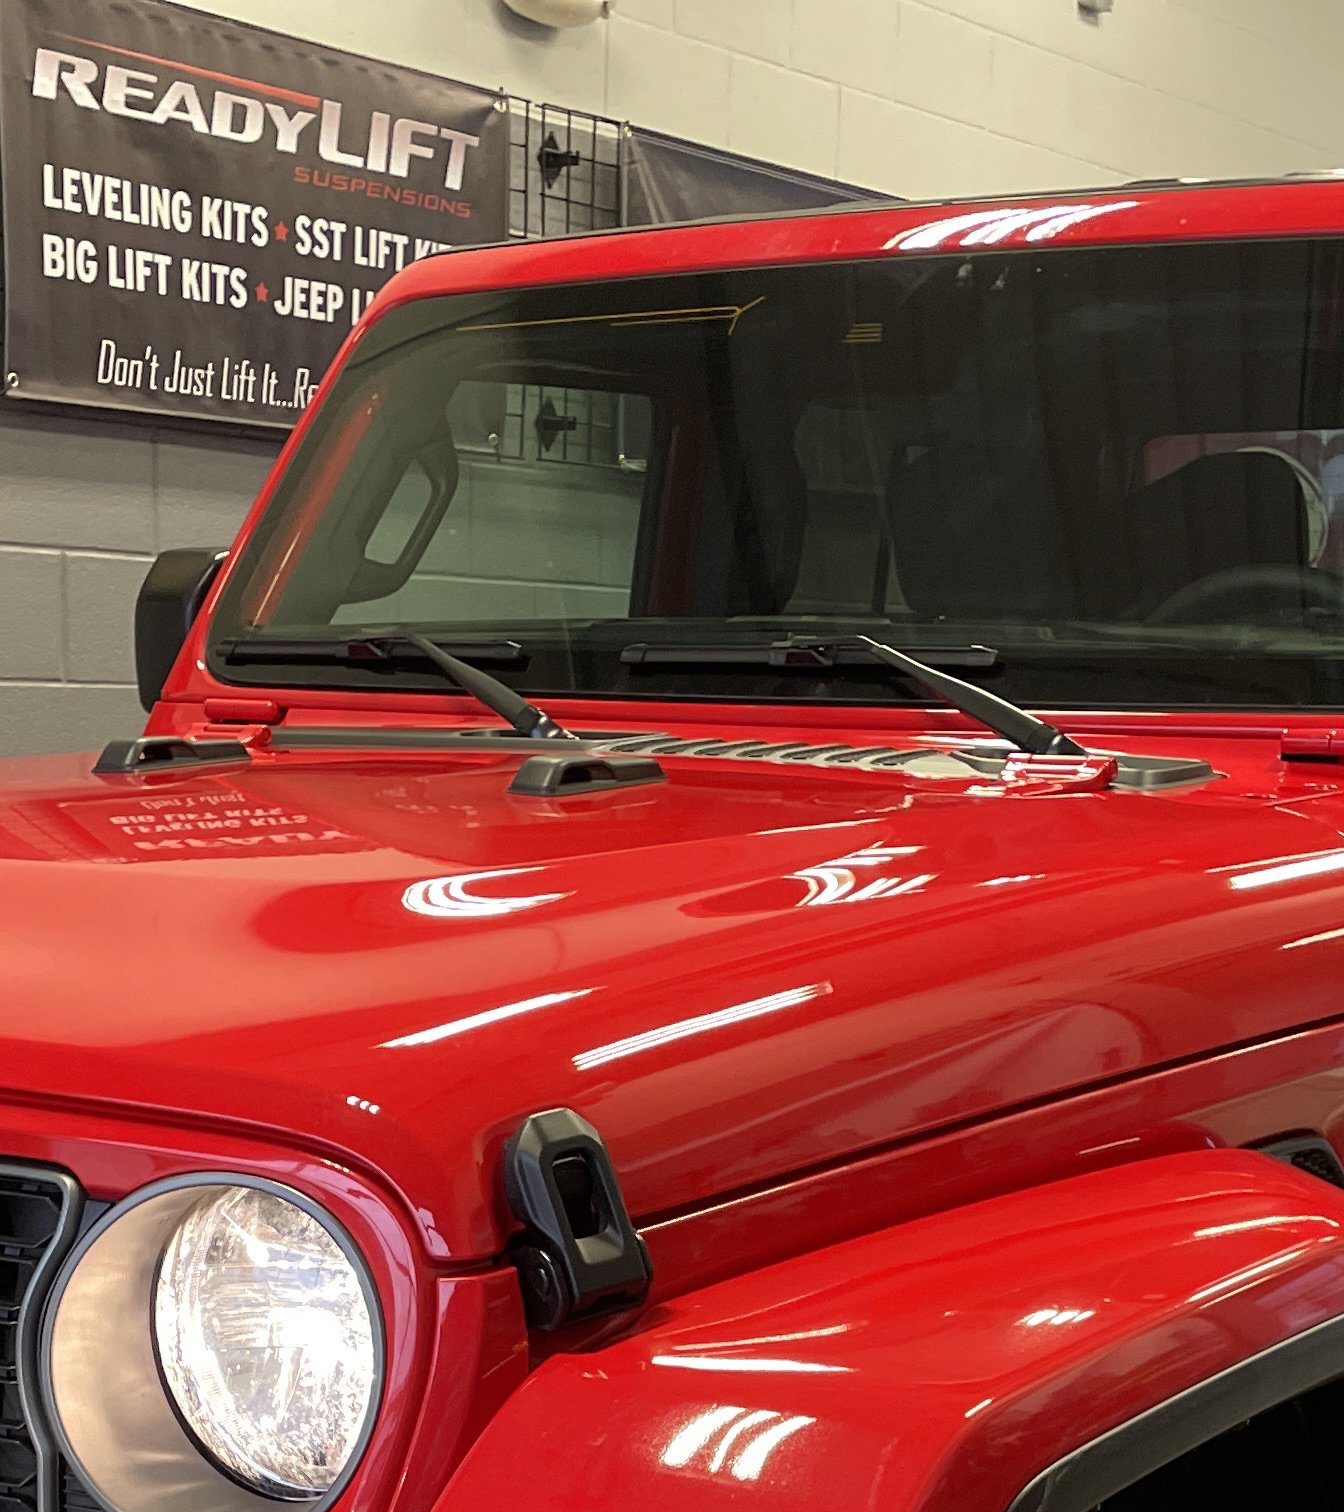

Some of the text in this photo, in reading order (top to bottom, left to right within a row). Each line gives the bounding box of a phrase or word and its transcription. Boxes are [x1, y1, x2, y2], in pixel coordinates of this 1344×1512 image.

[43, 163, 193, 233] LEVELING
[201, 196, 270, 247] KITS
[294, 214, 347, 261] SST
[354, 226, 409, 272] LIFT
[293, 166, 472, 218] SUSPENSIONS
[43, 233, 98, 284] BIG
[108, 245, 172, 296] LIFT
[181, 258, 248, 308] KITS
[274, 276, 344, 322] JEEP
[97, 339, 159, 390] Don't
[164, 350, 215, 398] Just
[221, 357, 257, 403] Lift
